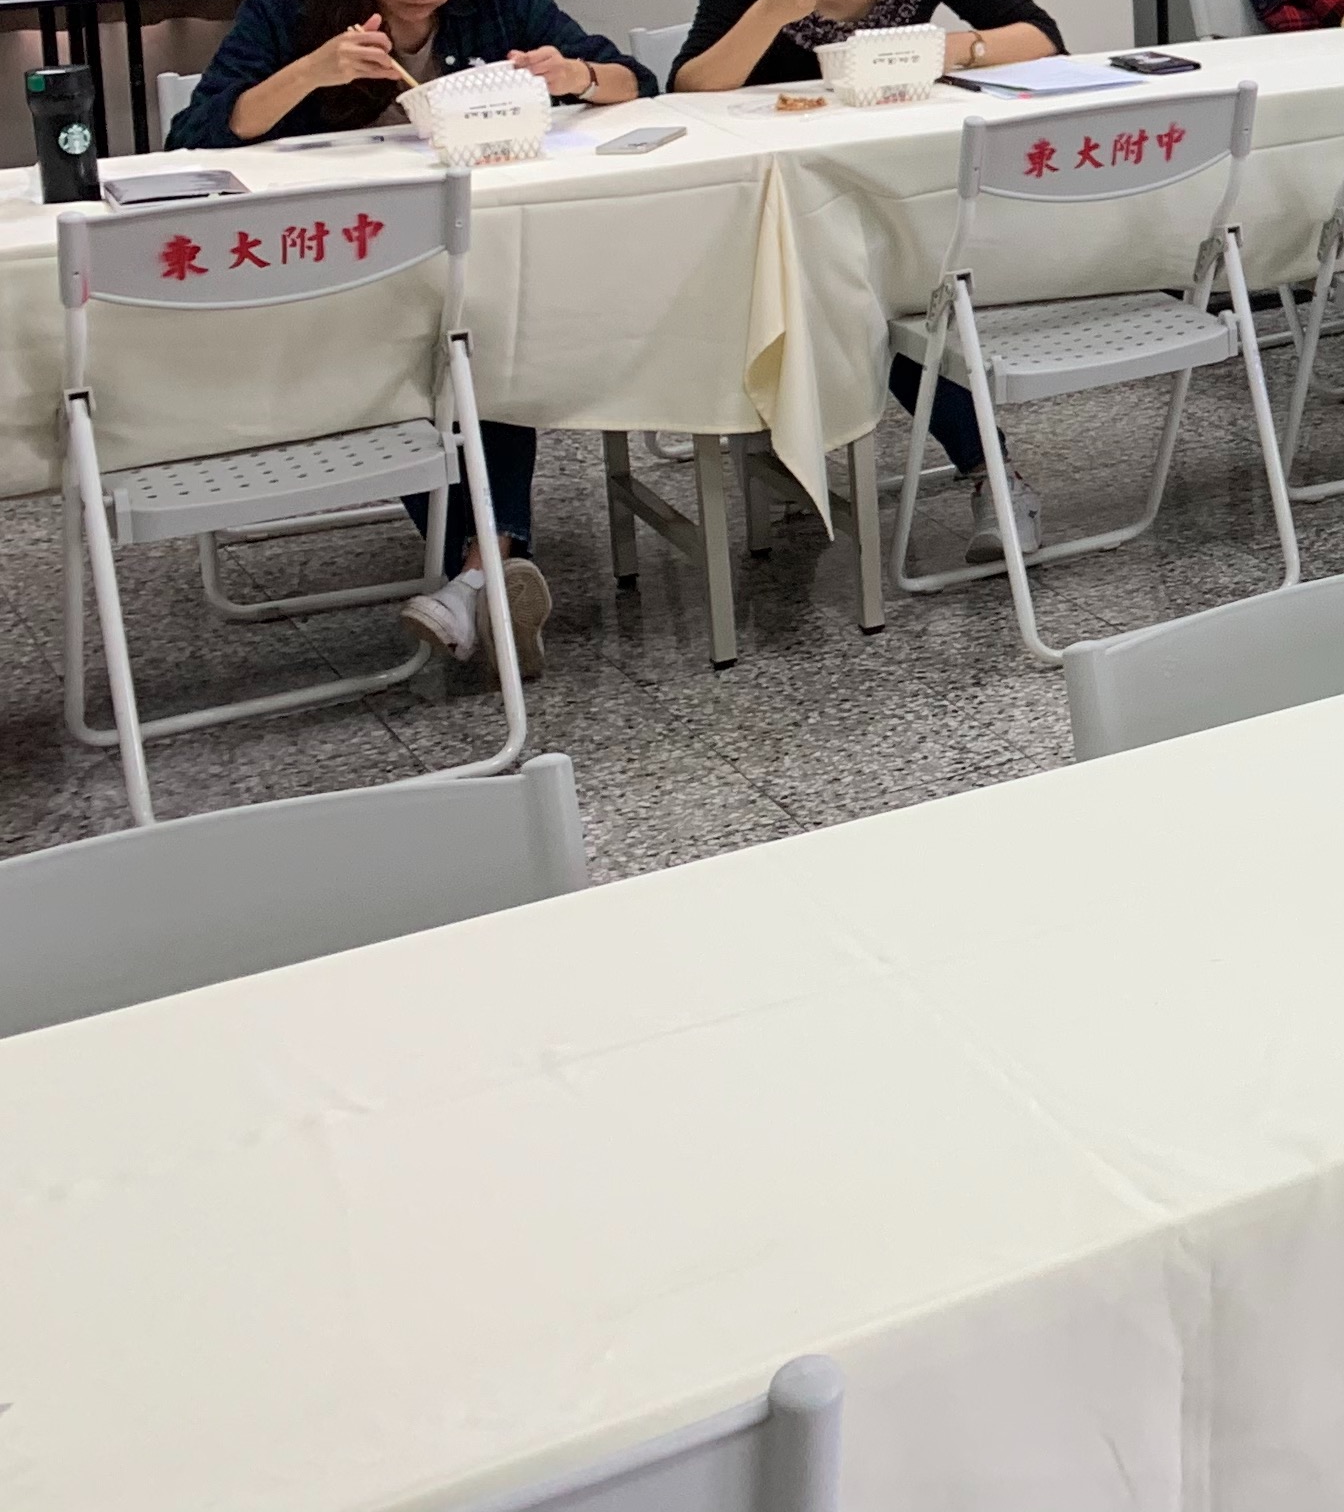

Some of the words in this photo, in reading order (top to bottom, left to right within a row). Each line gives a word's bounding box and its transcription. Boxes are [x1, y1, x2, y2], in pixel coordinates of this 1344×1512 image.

[1024, 123, 1186, 178] 東大附中
[161, 213, 384, 281] 東大附中
